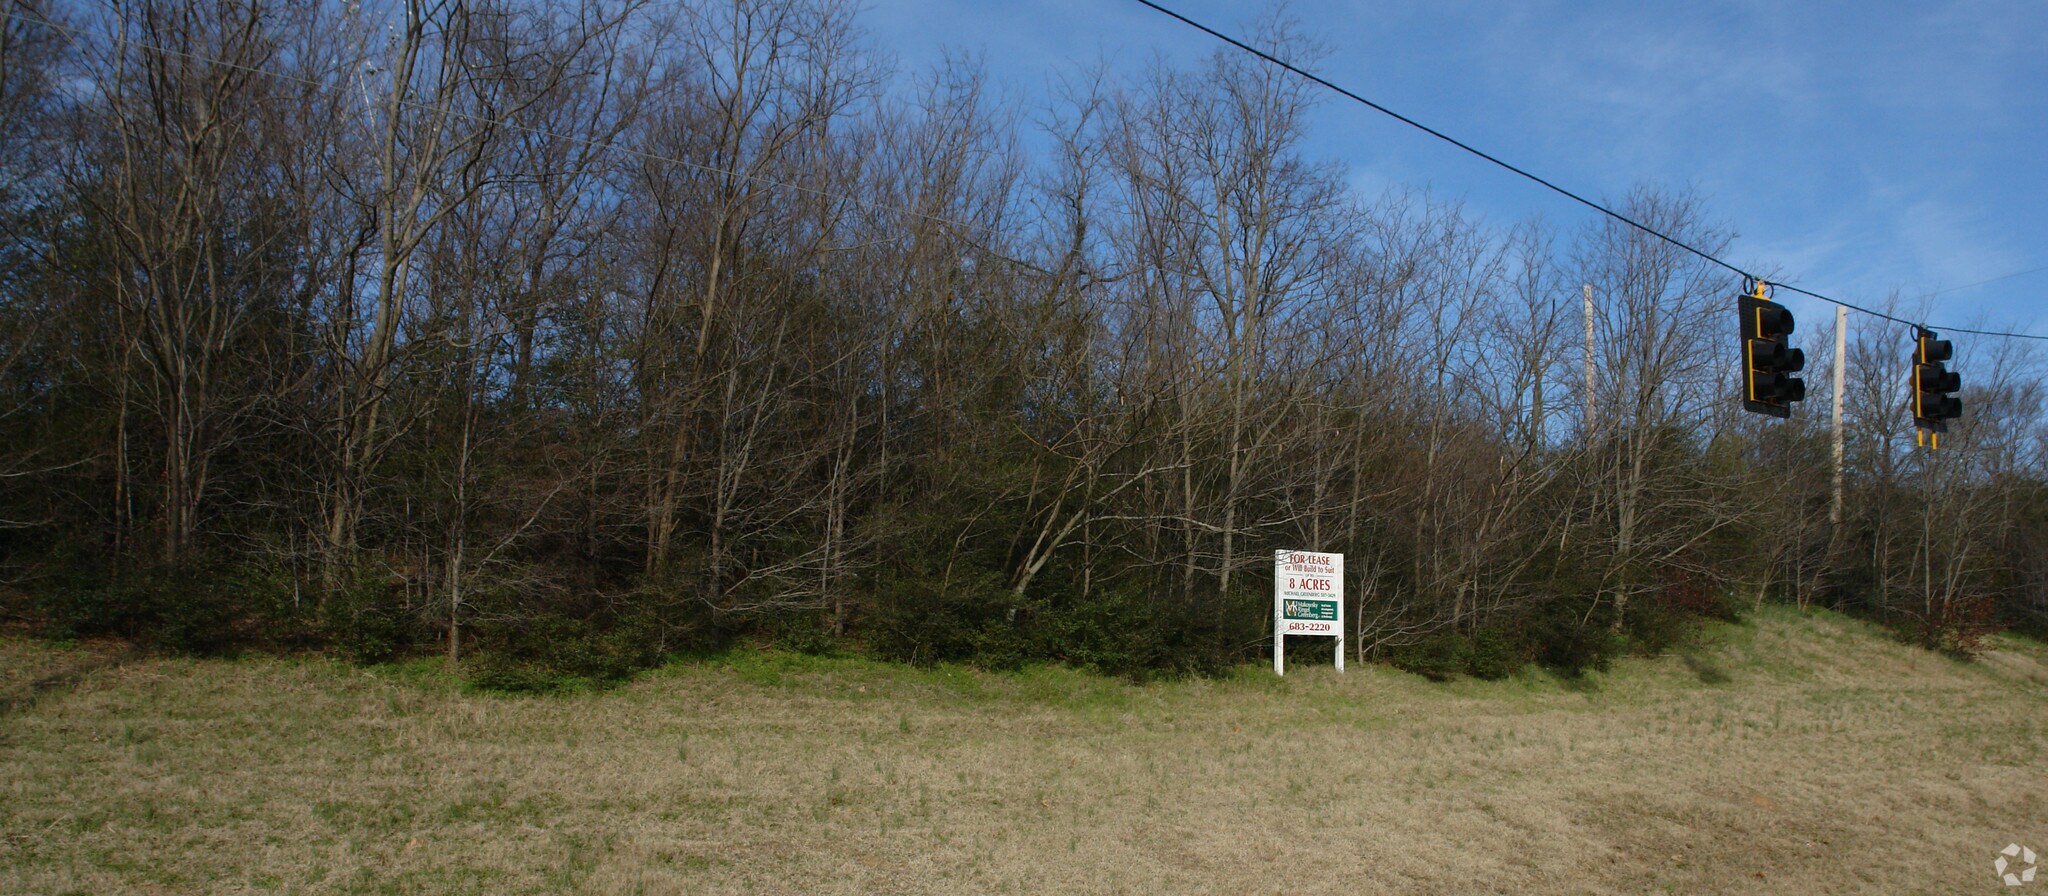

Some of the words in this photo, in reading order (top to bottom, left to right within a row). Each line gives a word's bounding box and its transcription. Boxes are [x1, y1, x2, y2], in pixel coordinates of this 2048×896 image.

[1290, 554, 1305, 564] FOR
[1309, 556, 1330, 565] LEASE
[1304, 565, 1316, 573] Build
[1289, 578, 1295, 589] 8
[1299, 578, 1330, 590] ACRES
[1289, 623, 1330, 631] 683-2220
